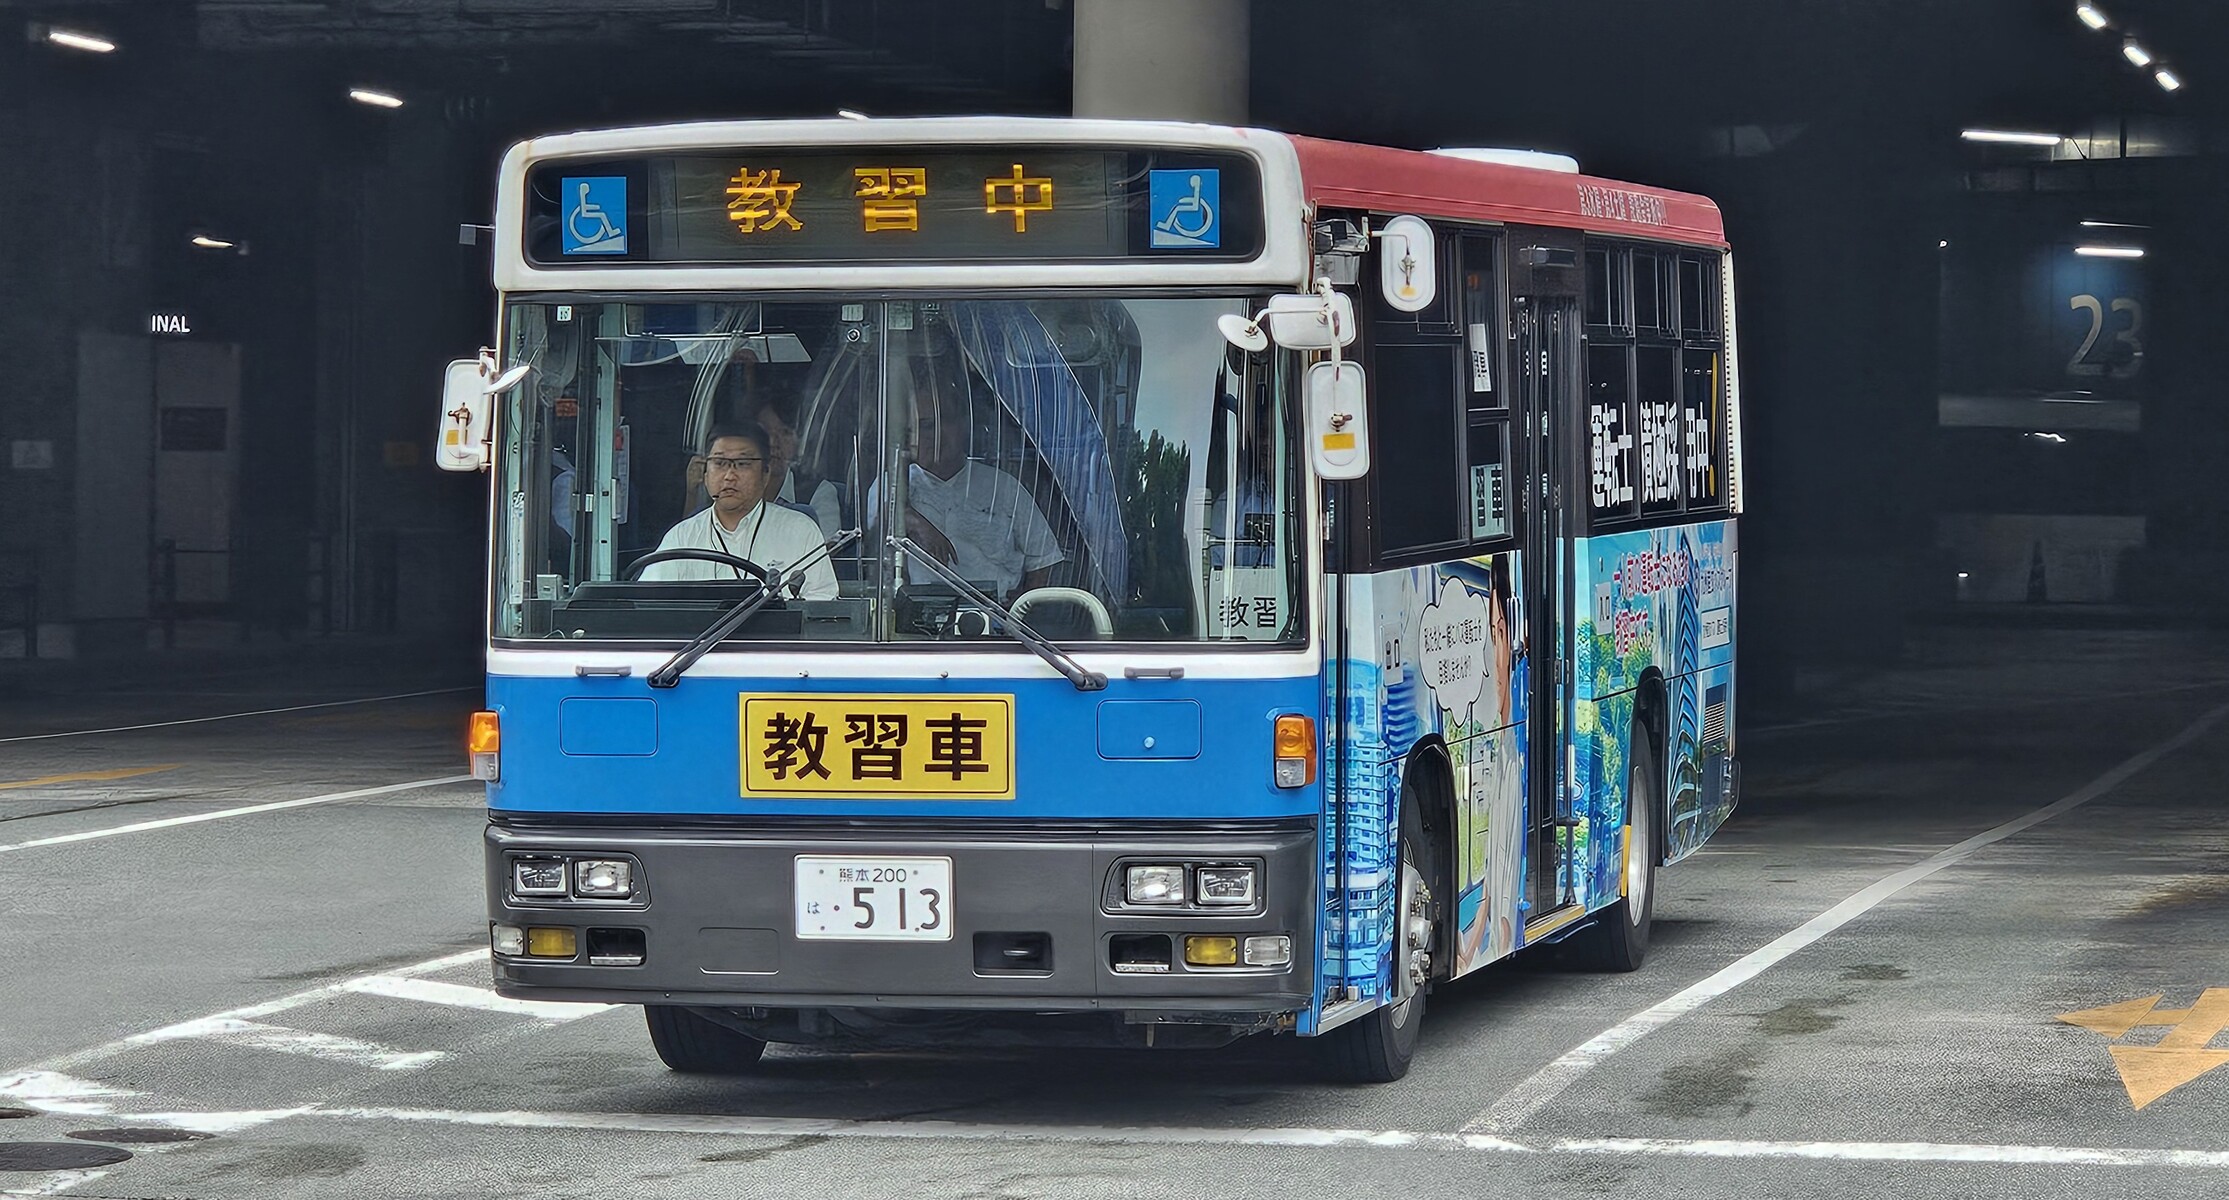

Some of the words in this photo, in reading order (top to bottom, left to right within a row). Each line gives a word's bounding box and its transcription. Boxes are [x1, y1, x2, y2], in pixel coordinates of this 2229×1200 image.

[726, 164, 1054, 233] 教習中
[2066, 293, 2144, 378] 23
[763, 711, 989, 781] 教習車
[807, 901, 821, 915] は
